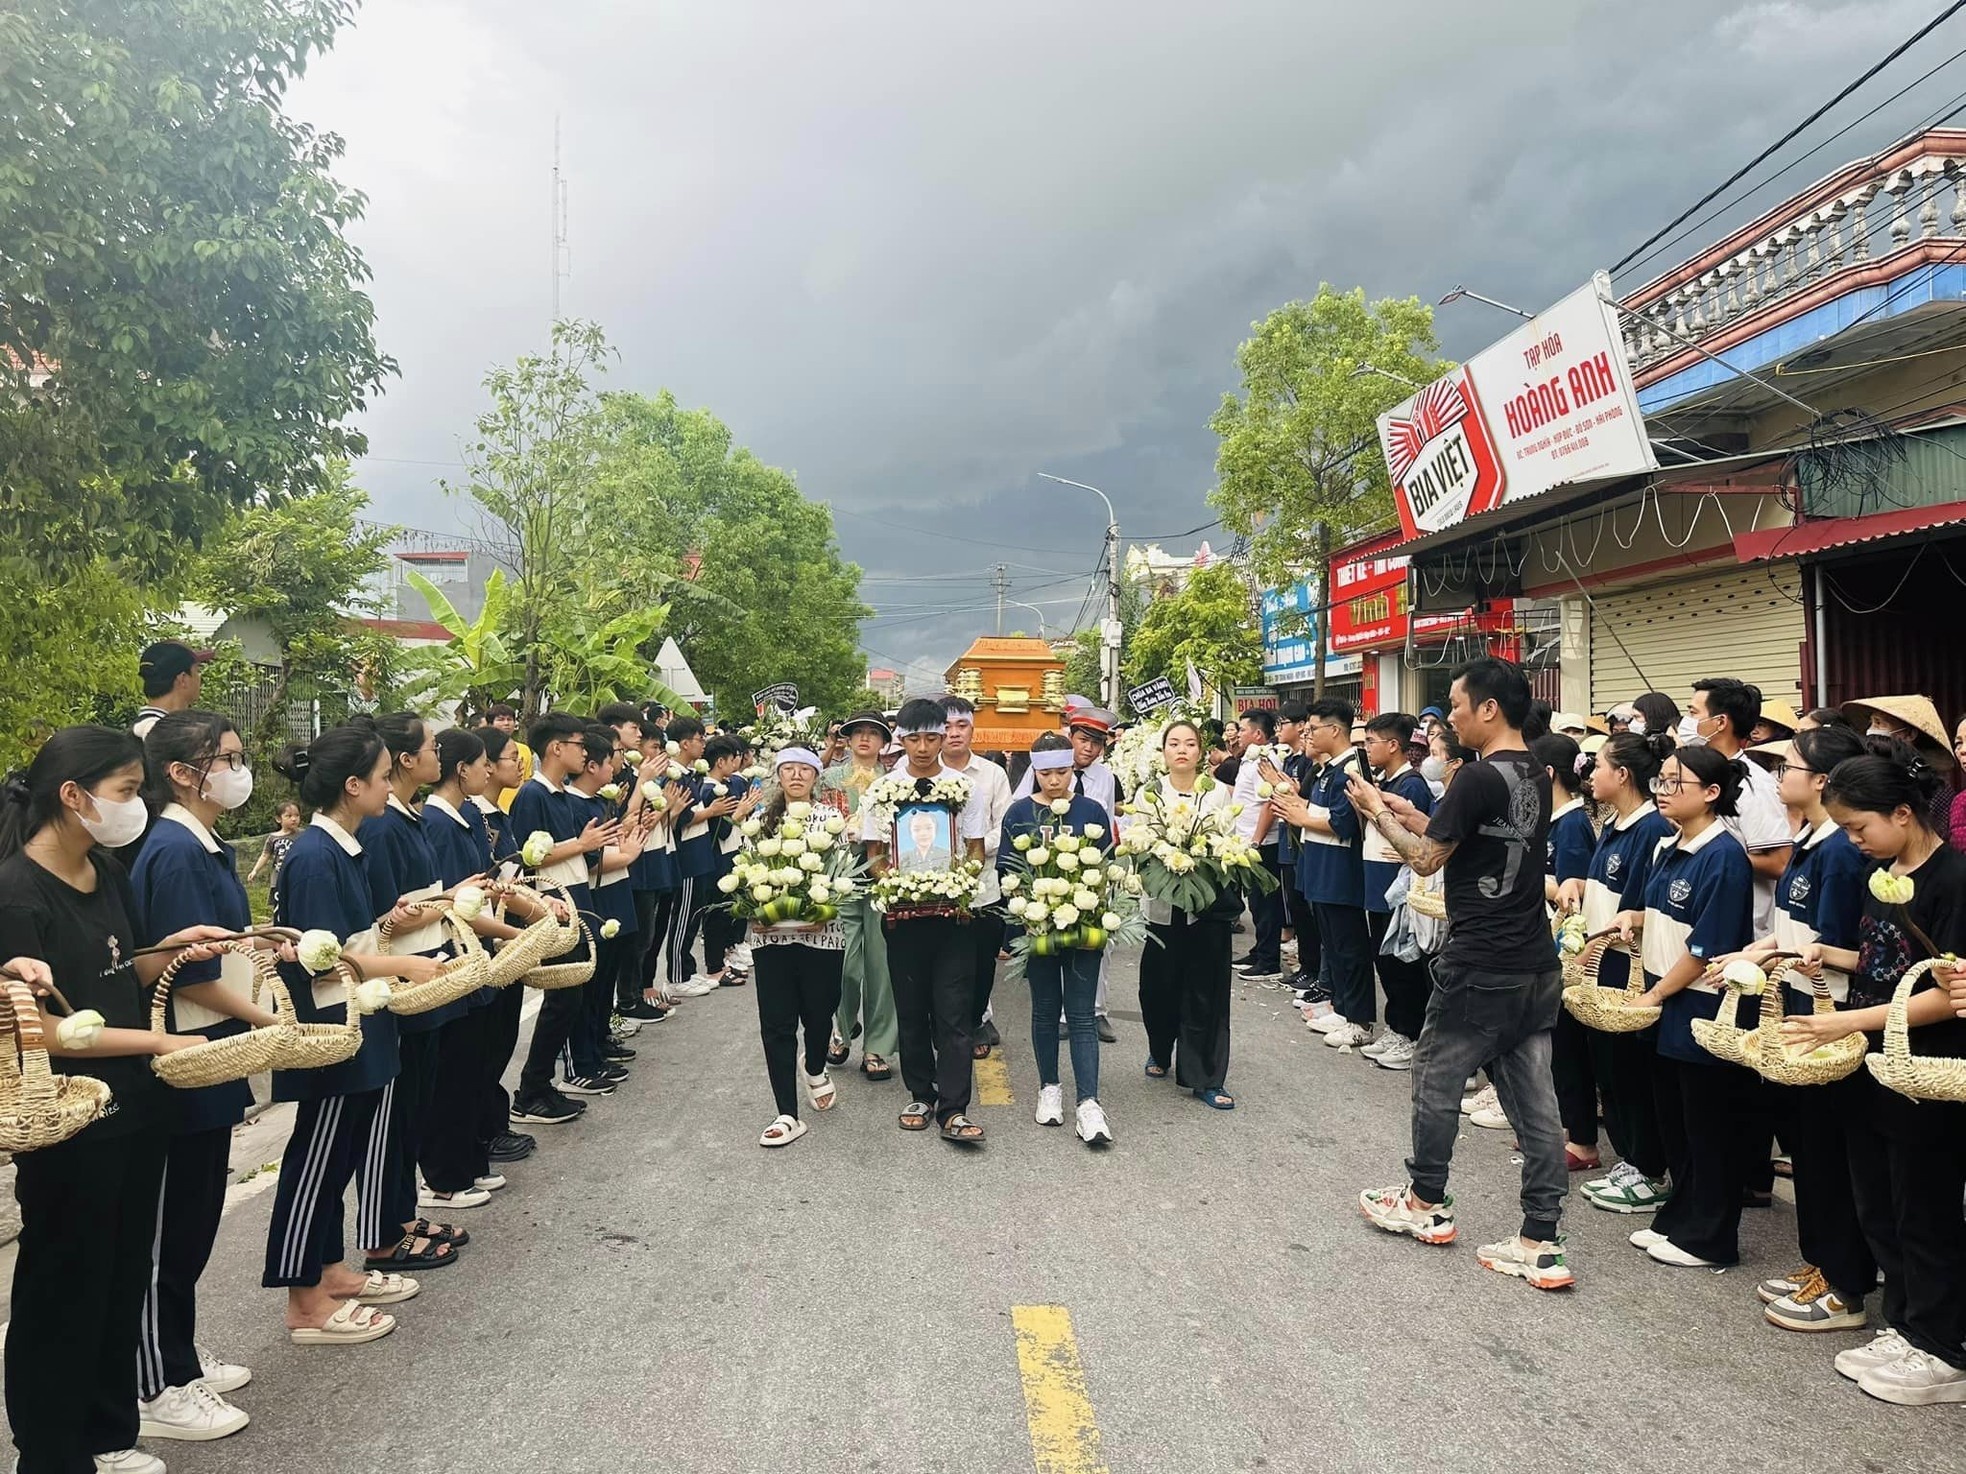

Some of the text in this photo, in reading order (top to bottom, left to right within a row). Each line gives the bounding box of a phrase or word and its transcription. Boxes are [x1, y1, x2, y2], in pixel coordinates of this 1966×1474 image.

[1523, 331, 1563, 371] TẠP HÓA
[1503, 351, 1616, 439] HOÀNG ANH
[1407, 467, 1440, 519] BIA
[1430, 433, 1470, 495] VIỆT
[1238, 698, 1255, 713] BIA
[401, 1233, 417, 1251] DIOR
